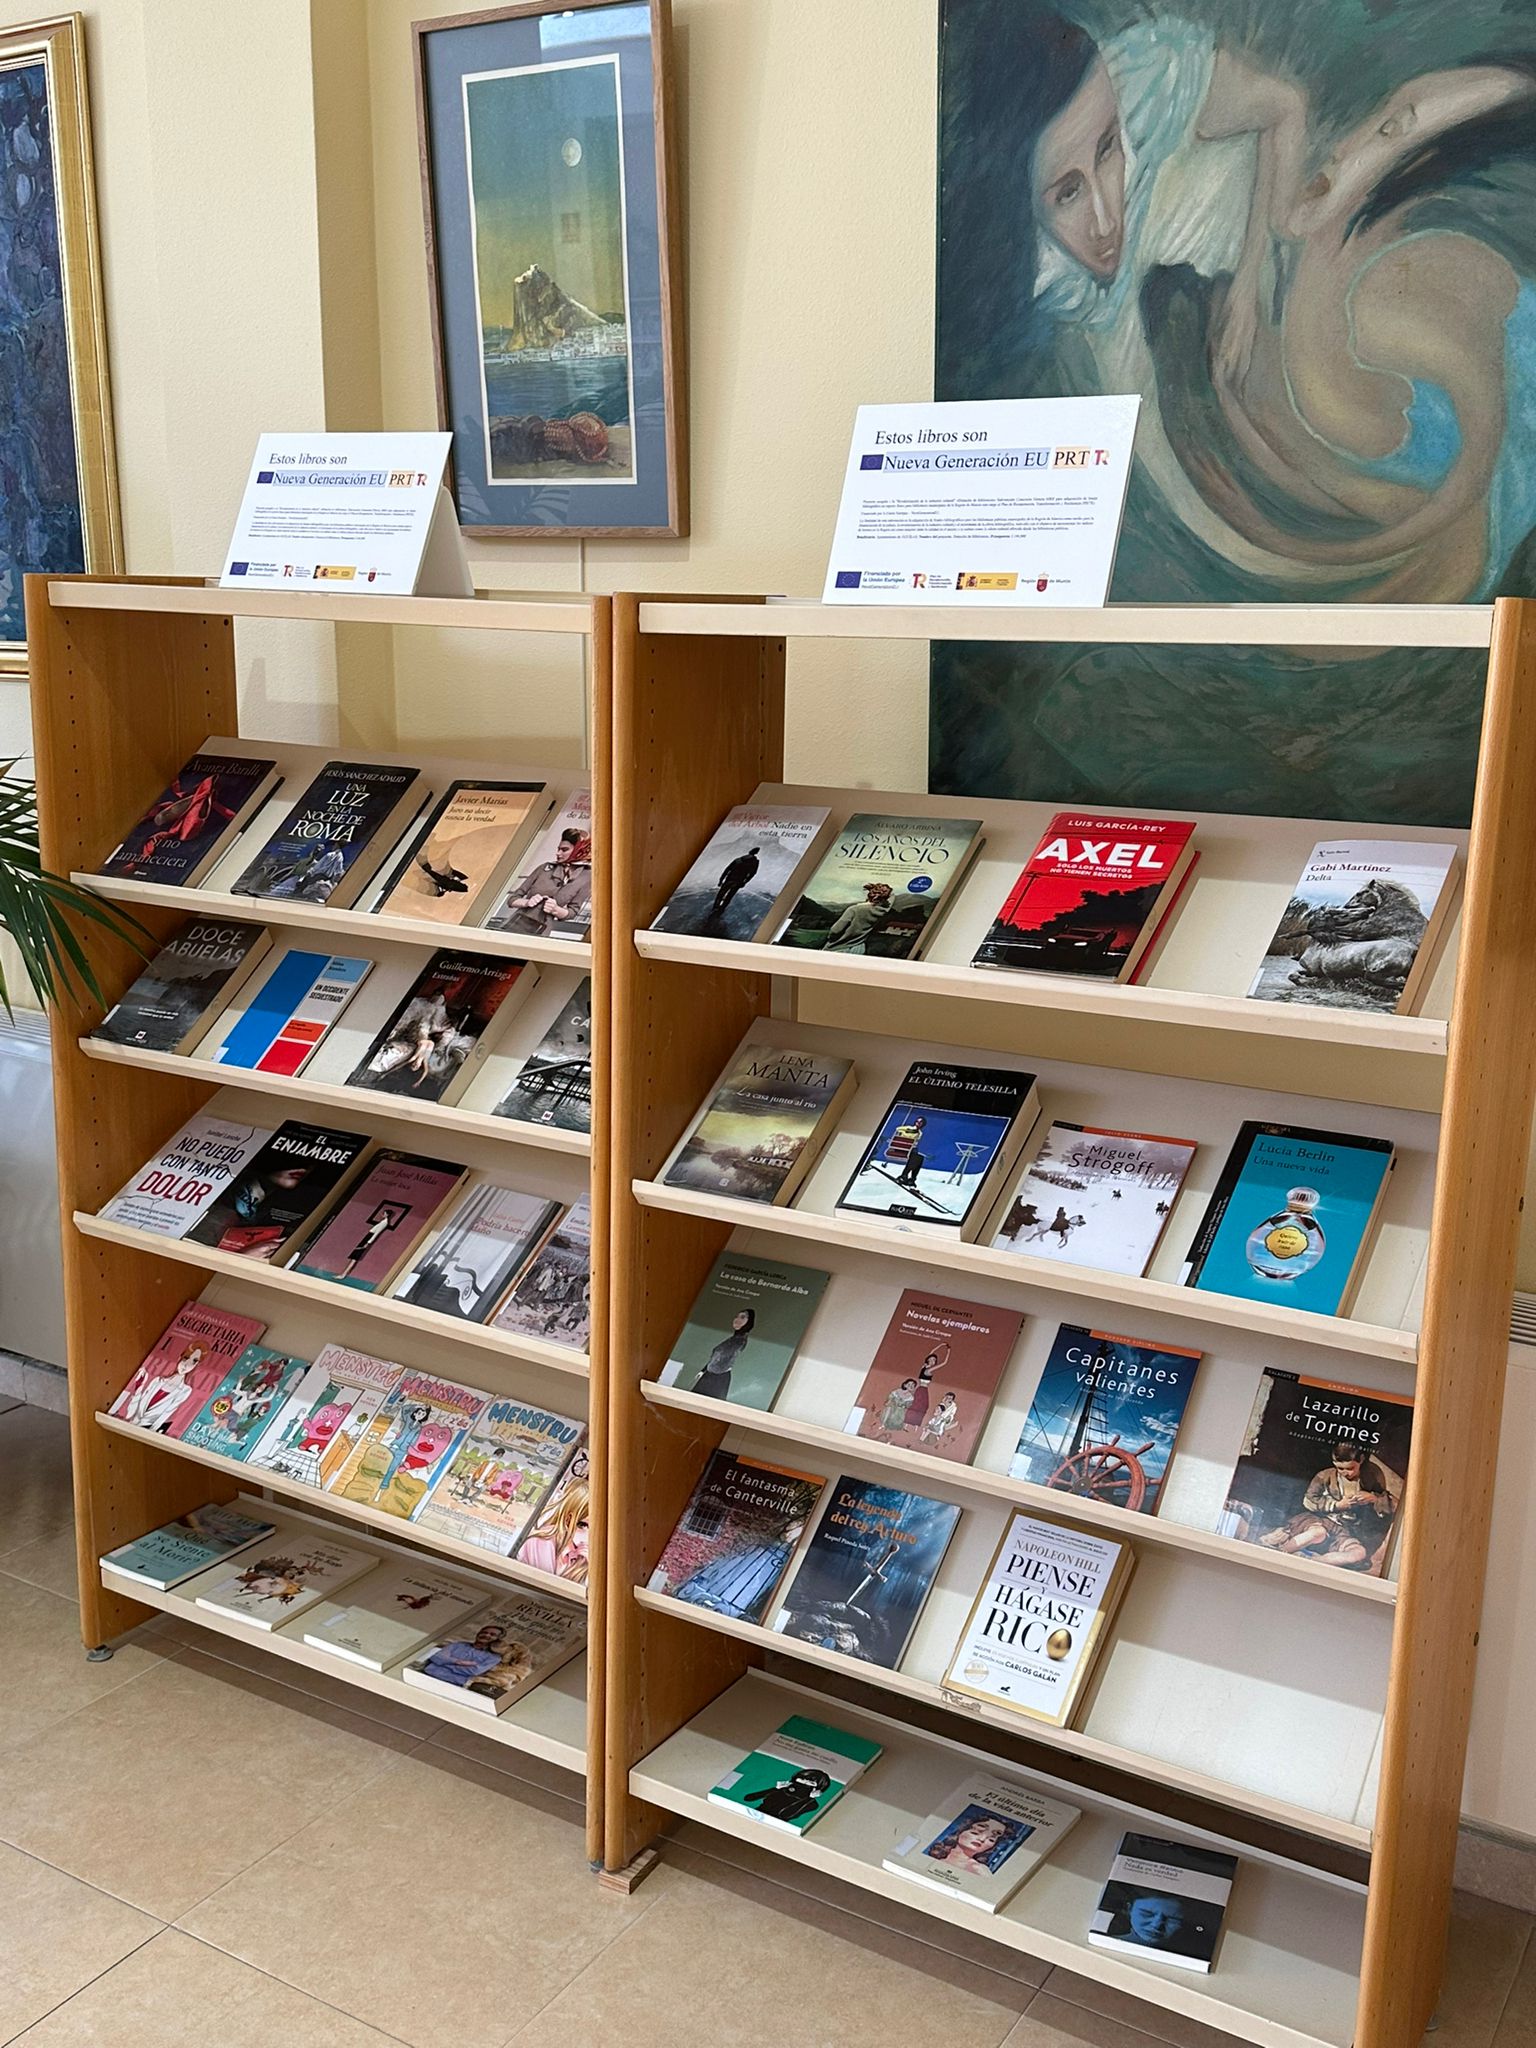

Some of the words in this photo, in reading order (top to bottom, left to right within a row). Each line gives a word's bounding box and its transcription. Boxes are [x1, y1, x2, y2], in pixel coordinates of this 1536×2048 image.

[875, 430, 913, 445] Estos
[917, 428, 958, 444] libros
[962, 430, 988, 443] son
[269, 452, 297, 464] Estos
[299, 452, 327, 464] libros
[330, 455, 348, 464] son
[884, 454, 930, 470] Nueva
[935, 451, 1019, 469] Generación
[1024, 451, 1050, 467] EU
[1053, 450, 1090, 466] PRT
[273, 472, 306, 485] Nueva
[309, 472, 367, 485] Generación
[369, 473, 388, 485] EU
[389, 473, 416, 485] PRT
[345, 782, 367, 792] UNA
[326, 790, 371, 807] LUZ
[302, 809, 347, 824] NOCHE
[345, 815, 367, 826] DE
[327, 805, 341, 813] EN
[340, 806, 353, 814] LA
[288, 819, 356, 842] ROMA
[758, 829, 778, 837] esta
[780, 830, 808, 839] tierra
[771, 821, 799, 830] Nadie
[1068, 820, 1092, 828] LUIS
[1095, 821, 1167, 833] GARCÍA-REY
[163, 838, 180, 849] no
[854, 832, 880, 843] LOS
[921, 836, 946, 847] DEL
[835, 843, 949, 865] SILENCIO
[1034, 838, 1165, 869] AXEL
[1063, 868, 1091, 877] TIENEN
[1092, 870, 1133, 879] SECRETOS
[1095, 865, 1133, 874] MUERTOS
[1306, 873, 1332, 882] Delta
[1310, 863, 1337, 872] Gabi
[1340, 863, 1392, 873] Martínez
[187, 925, 246, 946] DOCE
[164, 940, 246, 964] ABUELAS
[438, 959, 481, 976] Guillermo
[480, 966, 513, 983] Arriaga
[779, 1054, 816, 1068] LENA
[746, 1062, 830, 1089] MANTA
[912, 1065, 933, 1075] John
[934, 1067, 958, 1079] Irving
[736, 1087, 751, 1098] La
[752, 1093, 769, 1101] casa
[770, 1095, 794, 1105] junto
[794, 1098, 803, 1106] al
[908, 1076, 921, 1084] EL
[923, 1076, 964, 1089] ÚLTIMO
[965, 1082, 1018, 1096] TELESILLA
[174, 1136, 201, 1153] NO
[196, 1141, 245, 1164] PUEDO
[271, 1136, 353, 1165] ENJAMBRE
[315, 1135, 328, 1145] EL
[1068, 1152, 1155, 1175] Strogoff
[1088, 1145, 1142, 1161] Miguel
[1296, 1147, 1336, 1163] Berlin
[160, 1153, 191, 1170] CON
[187, 1159, 230, 1180] TANTO
[1253, 1156, 1274, 1167] Una
[1276, 1162, 1306, 1172] nueva
[1309, 1165, 1331, 1176] vida
[136, 1170, 213, 1206] DOLOR
[720, 1271, 730, 1279] La
[730, 1275, 747, 1283] casa
[747, 1276, 757, 1285] de
[757, 1278, 791, 1292] Bernarda
[791, 1286, 809, 1295] Alba
[176, 1314, 246, 1345] SECRETARIA
[906, 1309, 941, 1324] Novelas
[941, 1317, 990, 1335] ejemplares
[211, 1339, 239, 1357] KIM
[319, 1350, 401, 1388] MENSTRU
[1065, 1346, 1179, 1386] Capitanes
[400, 1376, 486, 1414] MENSTRU
[1075, 1371, 1157, 1400] valientes
[1302, 1395, 1381, 1424] Lazarillo
[487, 1402, 578, 1444] MENSTRU
[1285, 1411, 1301, 1423] de
[1304, 1414, 1382, 1445] Tormes
[186, 1431, 227, 1452] SHOOTING
[725, 1468, 736, 1480] El
[738, 1472, 796, 1498] fantasma
[710, 1483, 723, 1493] de
[725, 1486, 799, 1515] Canterville
[838, 1493, 857, 1508] La
[830, 1511, 849, 1526] del
[849, 1517, 870, 1535] rey
[870, 1521, 918, 1546] Arturo
[140, 1541, 157, 1550] al
[171, 1540, 211, 1558] Siente
[1014, 1538, 1074, 1565] NAPOLEON
[1075, 1557, 1102, 1574] HILL
[1005, 1553, 1096, 1598] PIENSE
[1041, 1587, 1047, 1595] Y
[516, 1603, 573, 1628] REVILLA
[994, 1584, 1084, 1629] HÁGASE
[1005, 1661, 1032, 1675] CARLOS
[985, 1791, 999, 1799] El
[998, 1796, 1029, 1811] último
[1029, 1808, 1046, 1817] día
[993, 1802, 1014, 1813] vida
[1013, 1810, 1055, 1827] anterior
